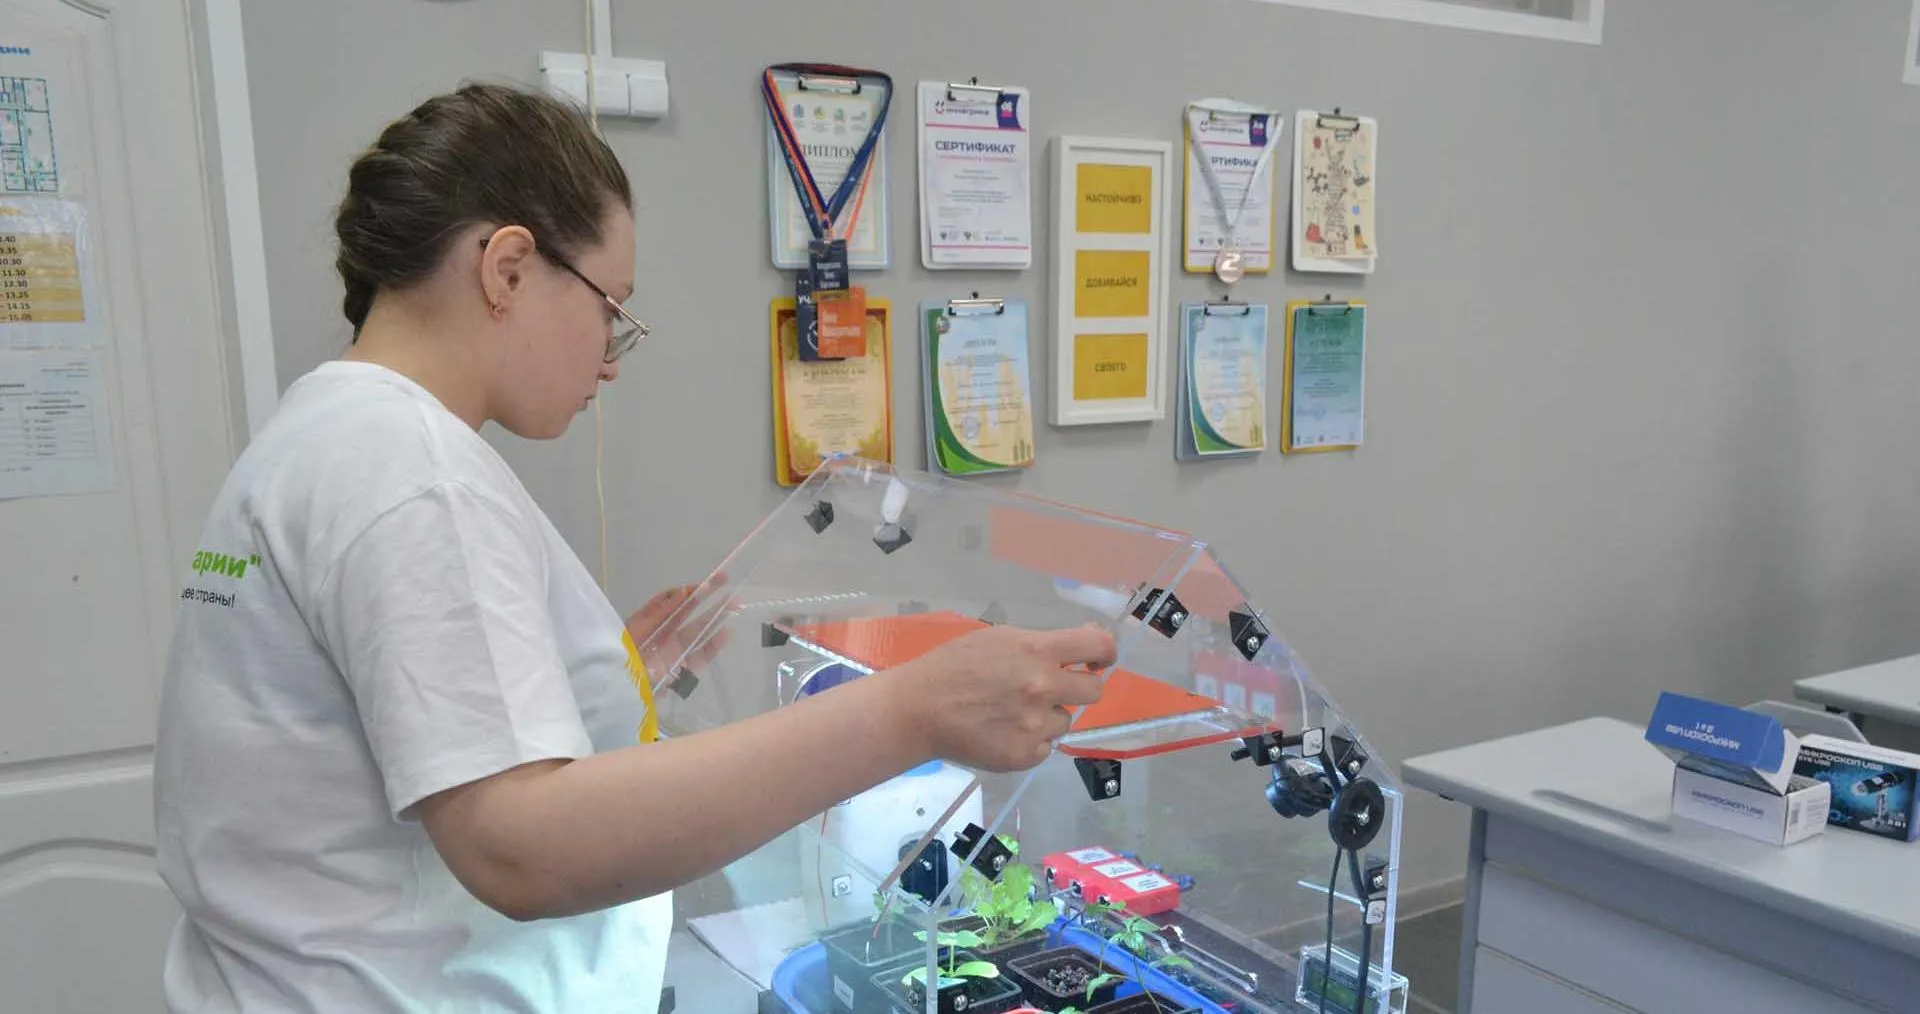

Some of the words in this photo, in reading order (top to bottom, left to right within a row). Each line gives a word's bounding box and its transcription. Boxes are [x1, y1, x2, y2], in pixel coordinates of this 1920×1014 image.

[935, 140, 1016, 154] СЕРТИФИКАТ
[1085, 192, 1142, 206] НАСТОЙЧИВО
[1220, 254, 1241, 271] 2
[1085, 275, 1137, 288] ДОБИВАЙСЯ
[1094, 361, 1127, 373] СВОЕГО
[195, 589, 235, 608] страны!
